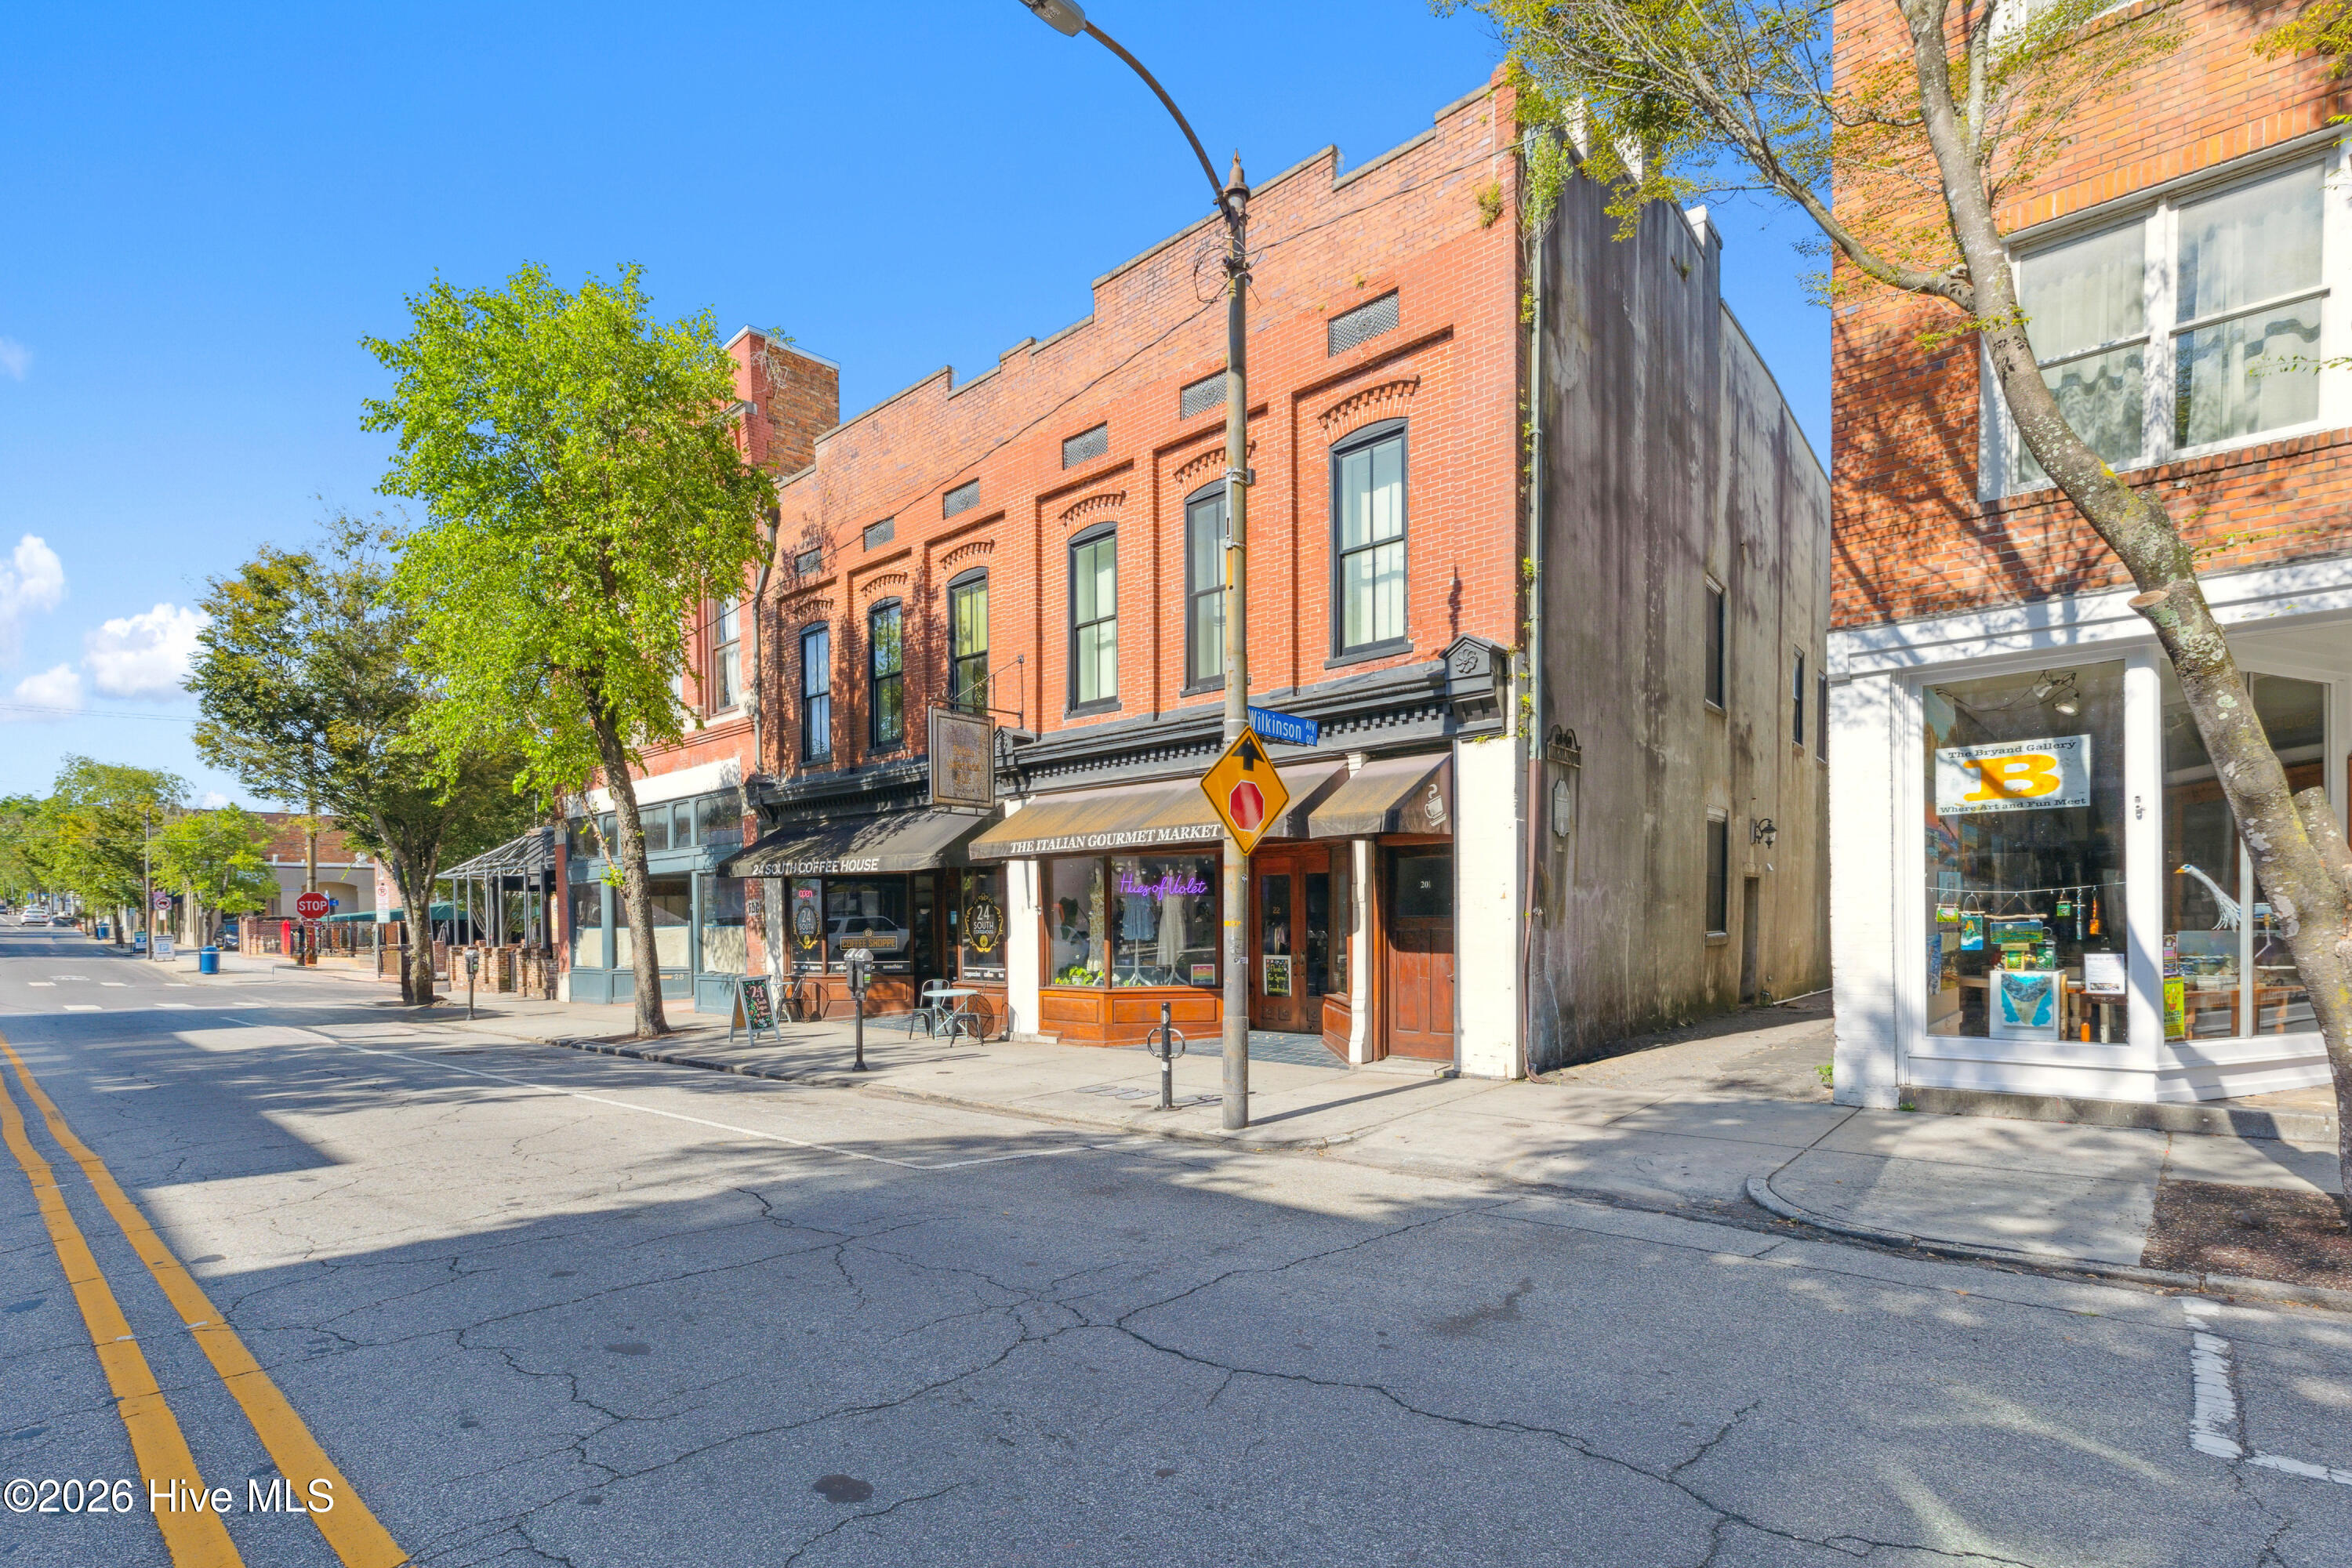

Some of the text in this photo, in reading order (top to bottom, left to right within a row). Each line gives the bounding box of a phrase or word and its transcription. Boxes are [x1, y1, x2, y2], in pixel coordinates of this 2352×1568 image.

[1248, 709, 1316, 740] Wilkinson Aly
[1306, 735, 1314, 745] 00
[1975, 745, 2023, 757] Bryand
[2027, 739, 2077, 752] Gallery
[1963, 754, 2060, 802] B
[1940, 804, 1978, 813] Where
[1980, 802, 1999, 811] Art
[2002, 800, 2024, 809] and
[2055, 797, 2086, 806] Meet
[1011, 824, 1221, 854] THE ITALIAN GOURMET MARKET
[753, 858, 880, 875] 24 SOUTH COFFEE HOUSE
[799, 889, 812, 898] open
[1119, 873, 1207, 900] Hues of Violet
[299, 901, 327, 910] STOP
[977, 905, 990, 920] 24
[1272, 906, 1280, 914] 22
[801, 909, 811, 922] 24
[974, 921, 993, 930] SOUTH
[841, 938, 895, 948] COFFEE SHOPPE
[750, 985, 764, 998] 24
